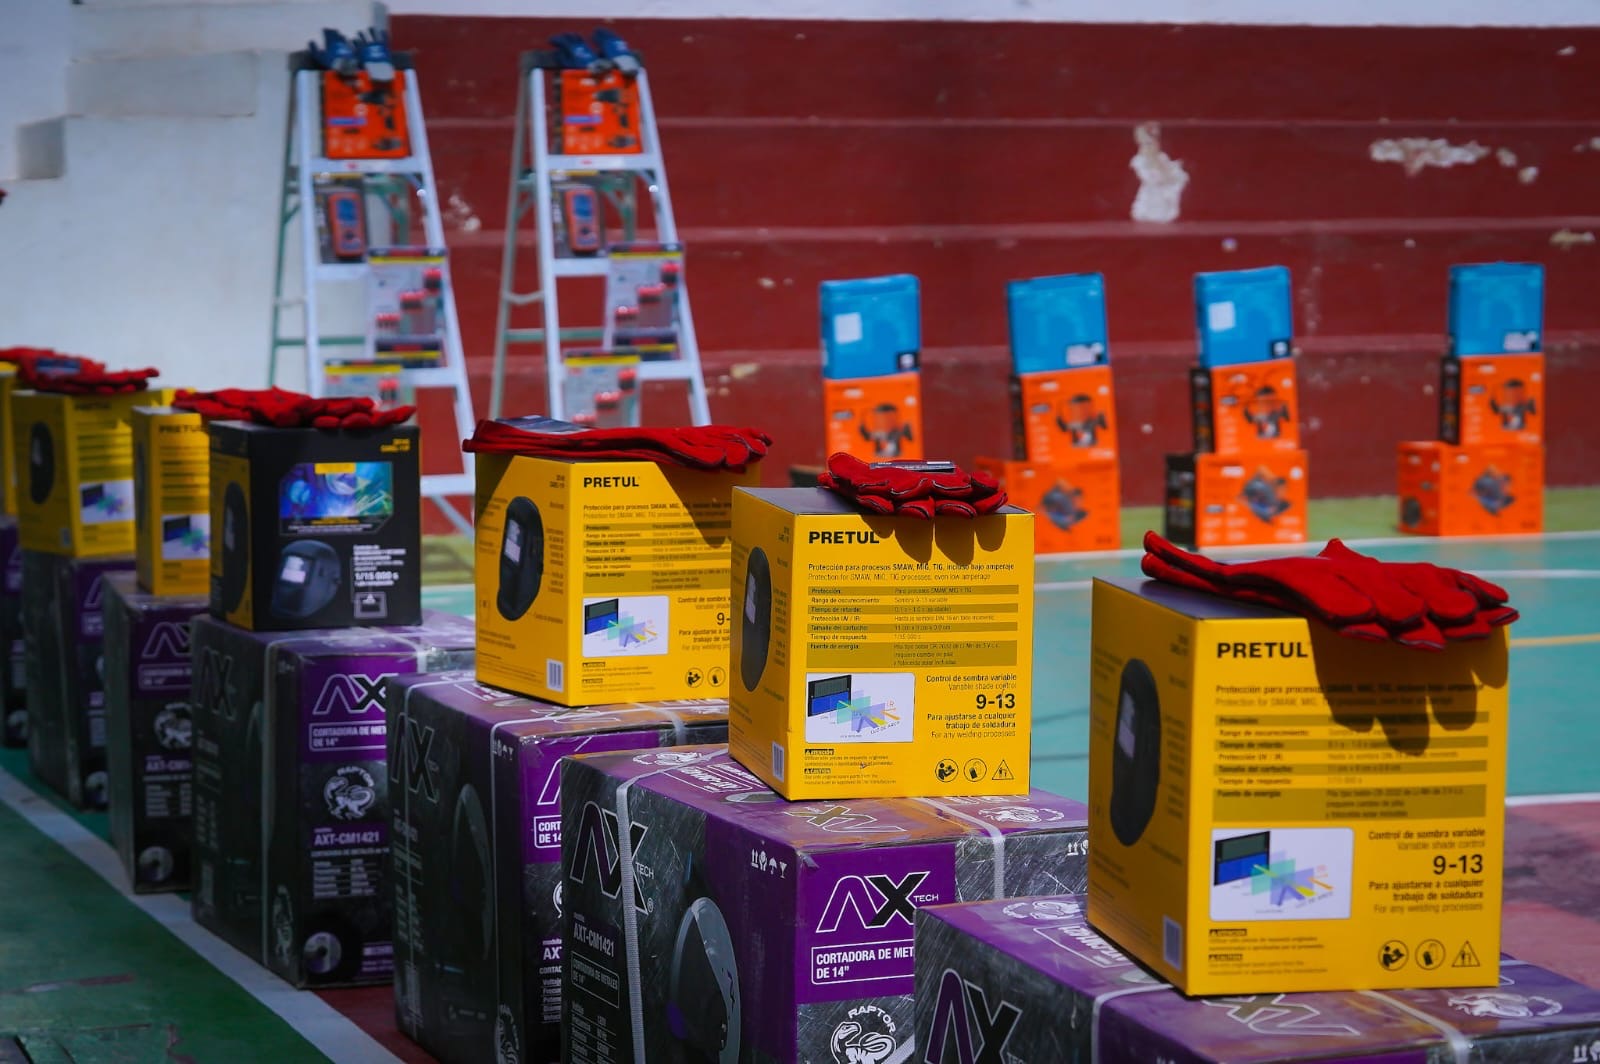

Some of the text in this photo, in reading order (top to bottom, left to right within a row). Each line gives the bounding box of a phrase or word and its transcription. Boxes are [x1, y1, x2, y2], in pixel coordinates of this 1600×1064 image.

[583, 476, 640, 488] PRETUL
[808, 531, 880, 545] PRETUL
[808, 563, 844, 571] Protección
[845, 564, 860, 572] para
[861, 564, 892, 572] procesos
[893, 563, 915, 571] SMAW,
[970, 563, 985, 571] bajo
[986, 563, 1015, 571] amperaje
[716, 612, 731, 626] 9-
[1216, 641, 1309, 659] PRETUL
[926, 673, 1017, 682] Control de sombra variable
[1263, 686, 1283, 694] para
[975, 693, 1016, 710] 9-13
[927, 713, 943, 721] Para
[944, 713, 977, 722] ajustarse
[984, 712, 1017, 720] cualquier
[370, 724, 387, 736] MET
[945, 722, 970, 731] trabajo
[982, 720, 1016, 729] soldadura
[1368, 828, 1486, 840] Control de sombra variable
[635, 861, 655, 880] TECH
[1432, 853, 1484, 876] 9-13
[1368, 881, 1390, 890] Para
[1391, 880, 1433, 891] ajustarse
[1442, 879, 1484, 889] cualquier
[912, 893, 939, 903] TECH
[1392, 890, 1484, 902] trabajo de soldadura
[573, 922, 615, 958] AXT-CM1421
[816, 945, 914, 965] CORTADORA DE MET
[816, 966, 830, 979] DE
[847, 1004, 896, 1034] RAPTOR
